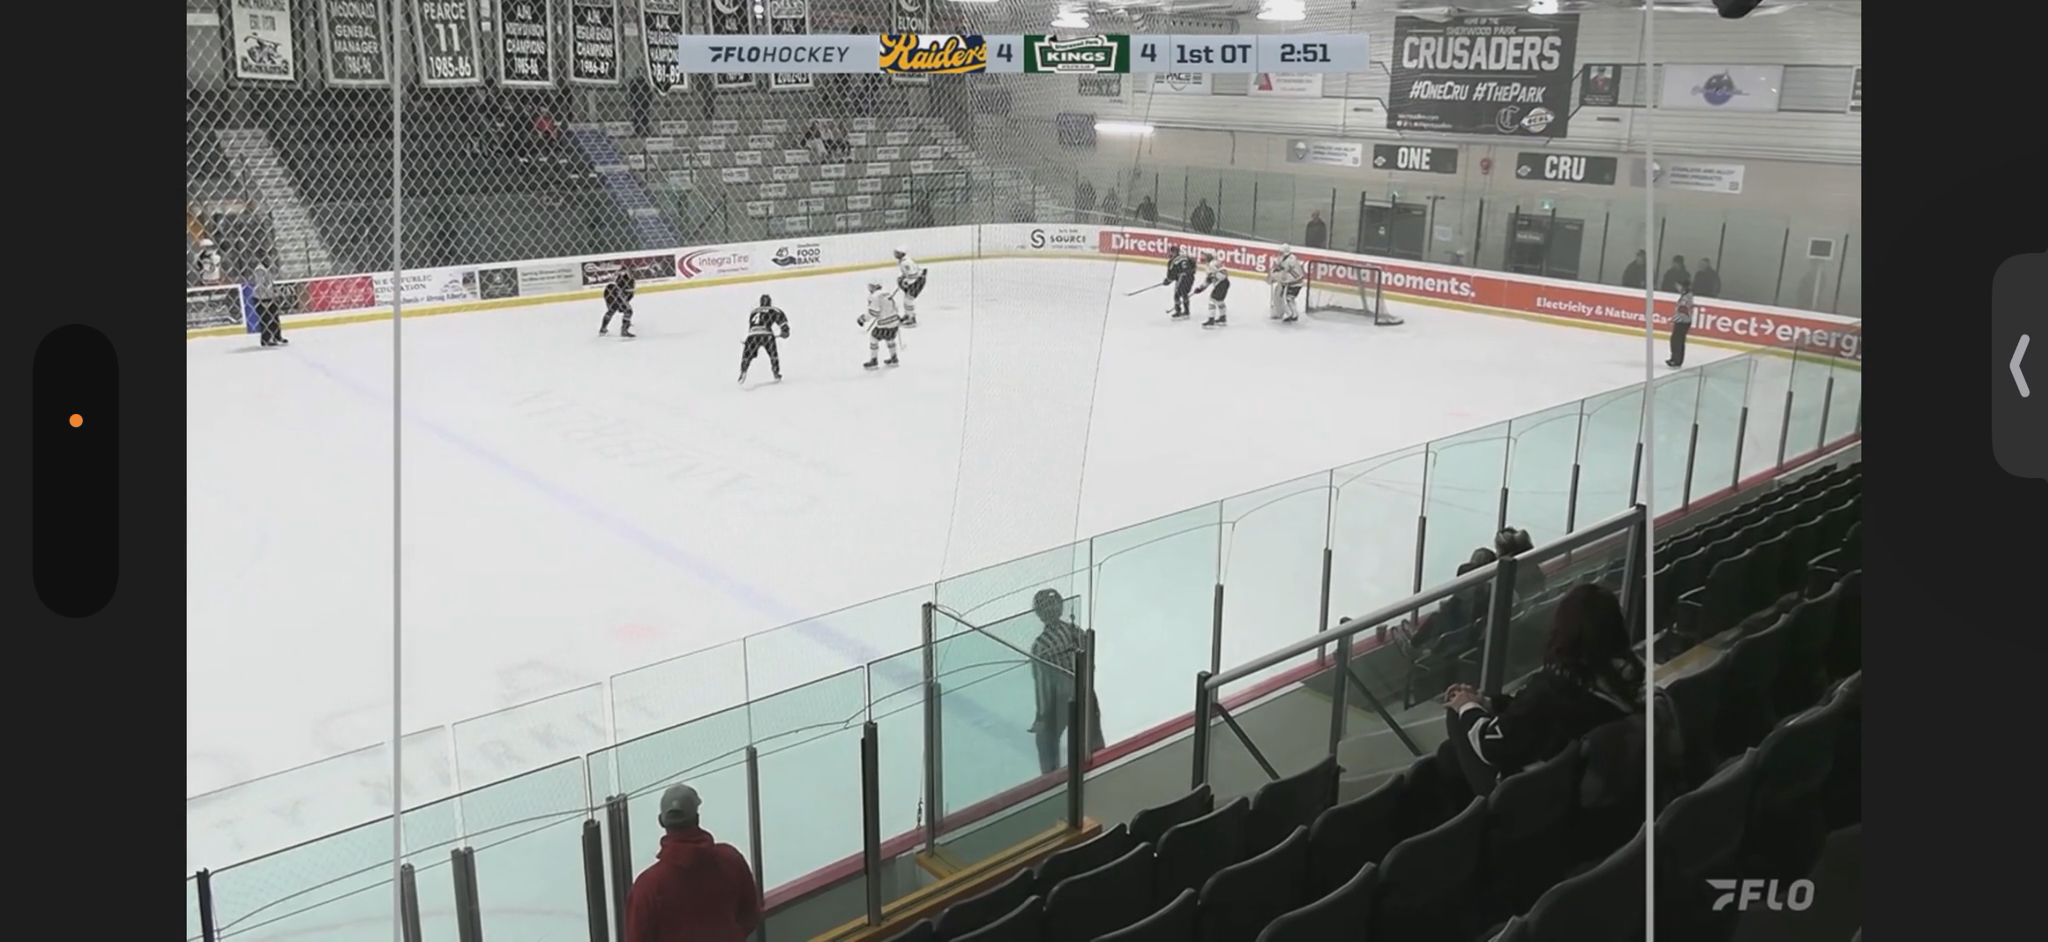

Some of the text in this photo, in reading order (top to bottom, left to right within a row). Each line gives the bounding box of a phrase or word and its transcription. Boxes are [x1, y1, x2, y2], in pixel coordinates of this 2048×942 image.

[423, 3, 466, 20] PEARCE
[335, 25, 376, 39] GENERAL
[897, 16, 925, 32] ELTON
[1493, 26, 1517, 35] PARK
[435, 23, 460, 52] 11
[334, 40, 379, 54] MANAGER
[506, 39, 546, 54] CHAMPIONS
[1402, 35, 1562, 71] CRUSADERS
[429, 56, 471, 77] 1985-86
[1397, 147, 1432, 170] ONE
[1544, 155, 1586, 181] CRU
[1049, 235, 1087, 244] SOURCE
[797, 248, 820, 256] FOOD
[796, 257, 821, 265] BANK
[375, 282, 427, 294] EDUATION
[1374, 268, 1475, 298] moments.
[1536, 296, 1592, 317] Electricity
[1595, 305, 1603, 316] &
[1604, 306, 1647, 323] Natura
[1776, 322, 1861, 359] energ
